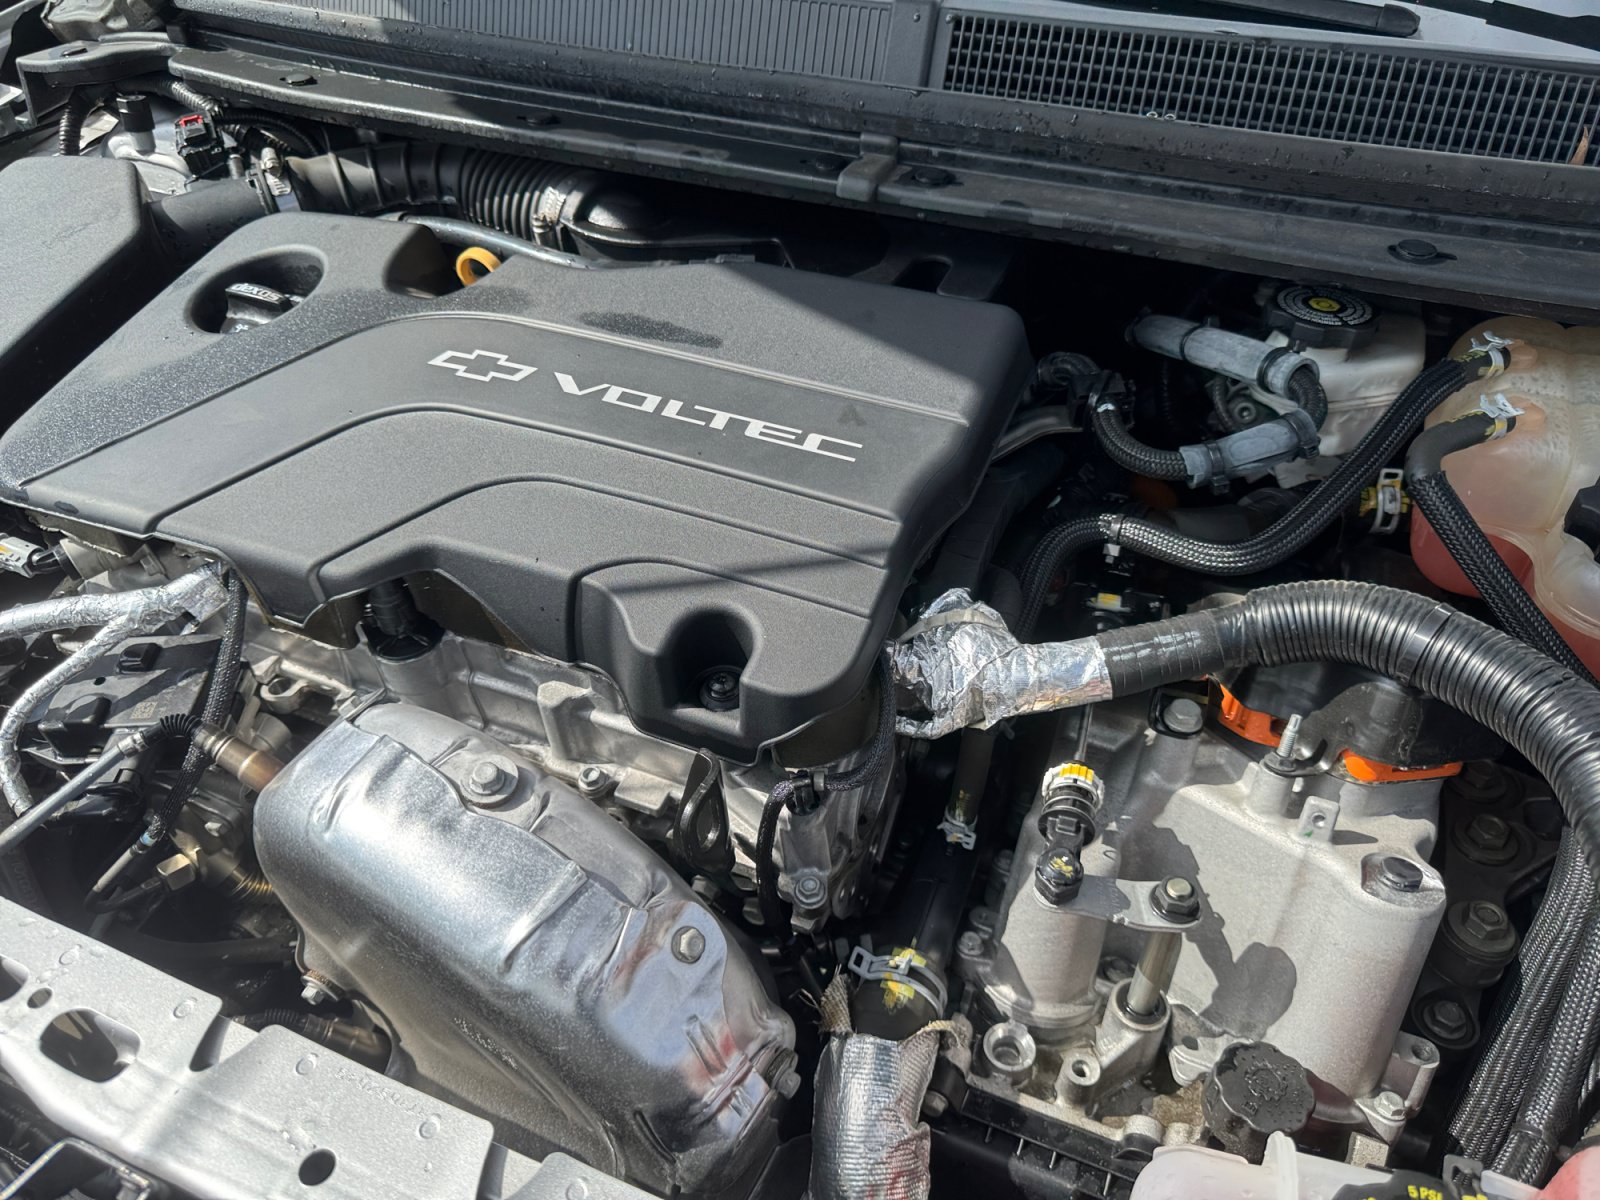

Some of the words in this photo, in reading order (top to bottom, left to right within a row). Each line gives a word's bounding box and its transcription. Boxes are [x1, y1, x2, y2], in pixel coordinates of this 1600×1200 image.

[231, 283, 282, 301] dexos
[555, 371, 863, 462] VOLTEC
[1408, 1186, 1418, 1199] 5
[1419, 1187, 1443, 1200] PSI
